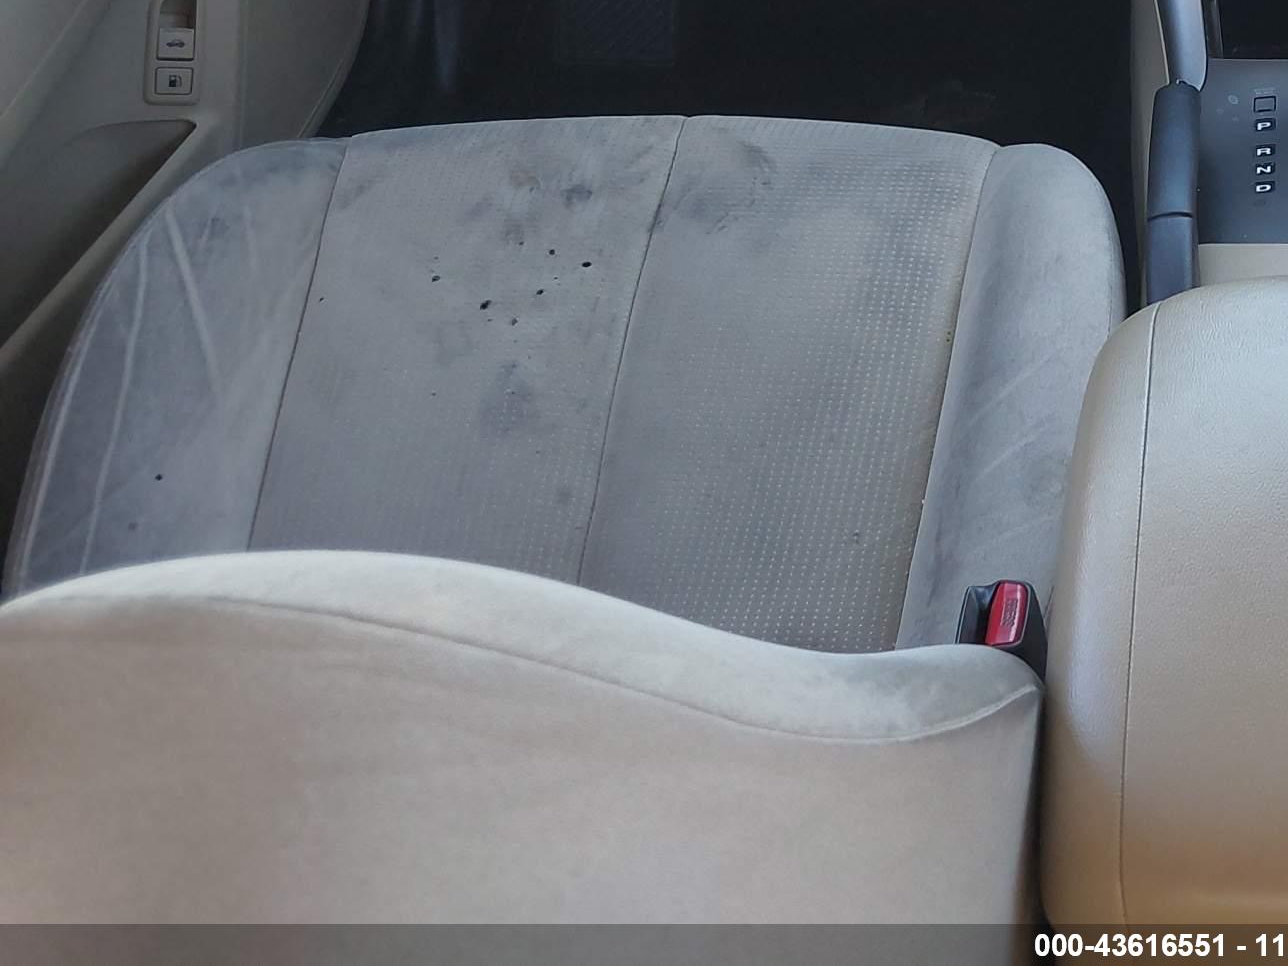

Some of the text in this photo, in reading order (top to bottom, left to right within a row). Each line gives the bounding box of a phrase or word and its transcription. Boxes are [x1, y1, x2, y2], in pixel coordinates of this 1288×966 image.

[1256, 121, 1272, 131] P
[1256, 147, 1272, 156] R
[1256, 166, 1272, 175] N
[1255, 184, 1272, 193] D
